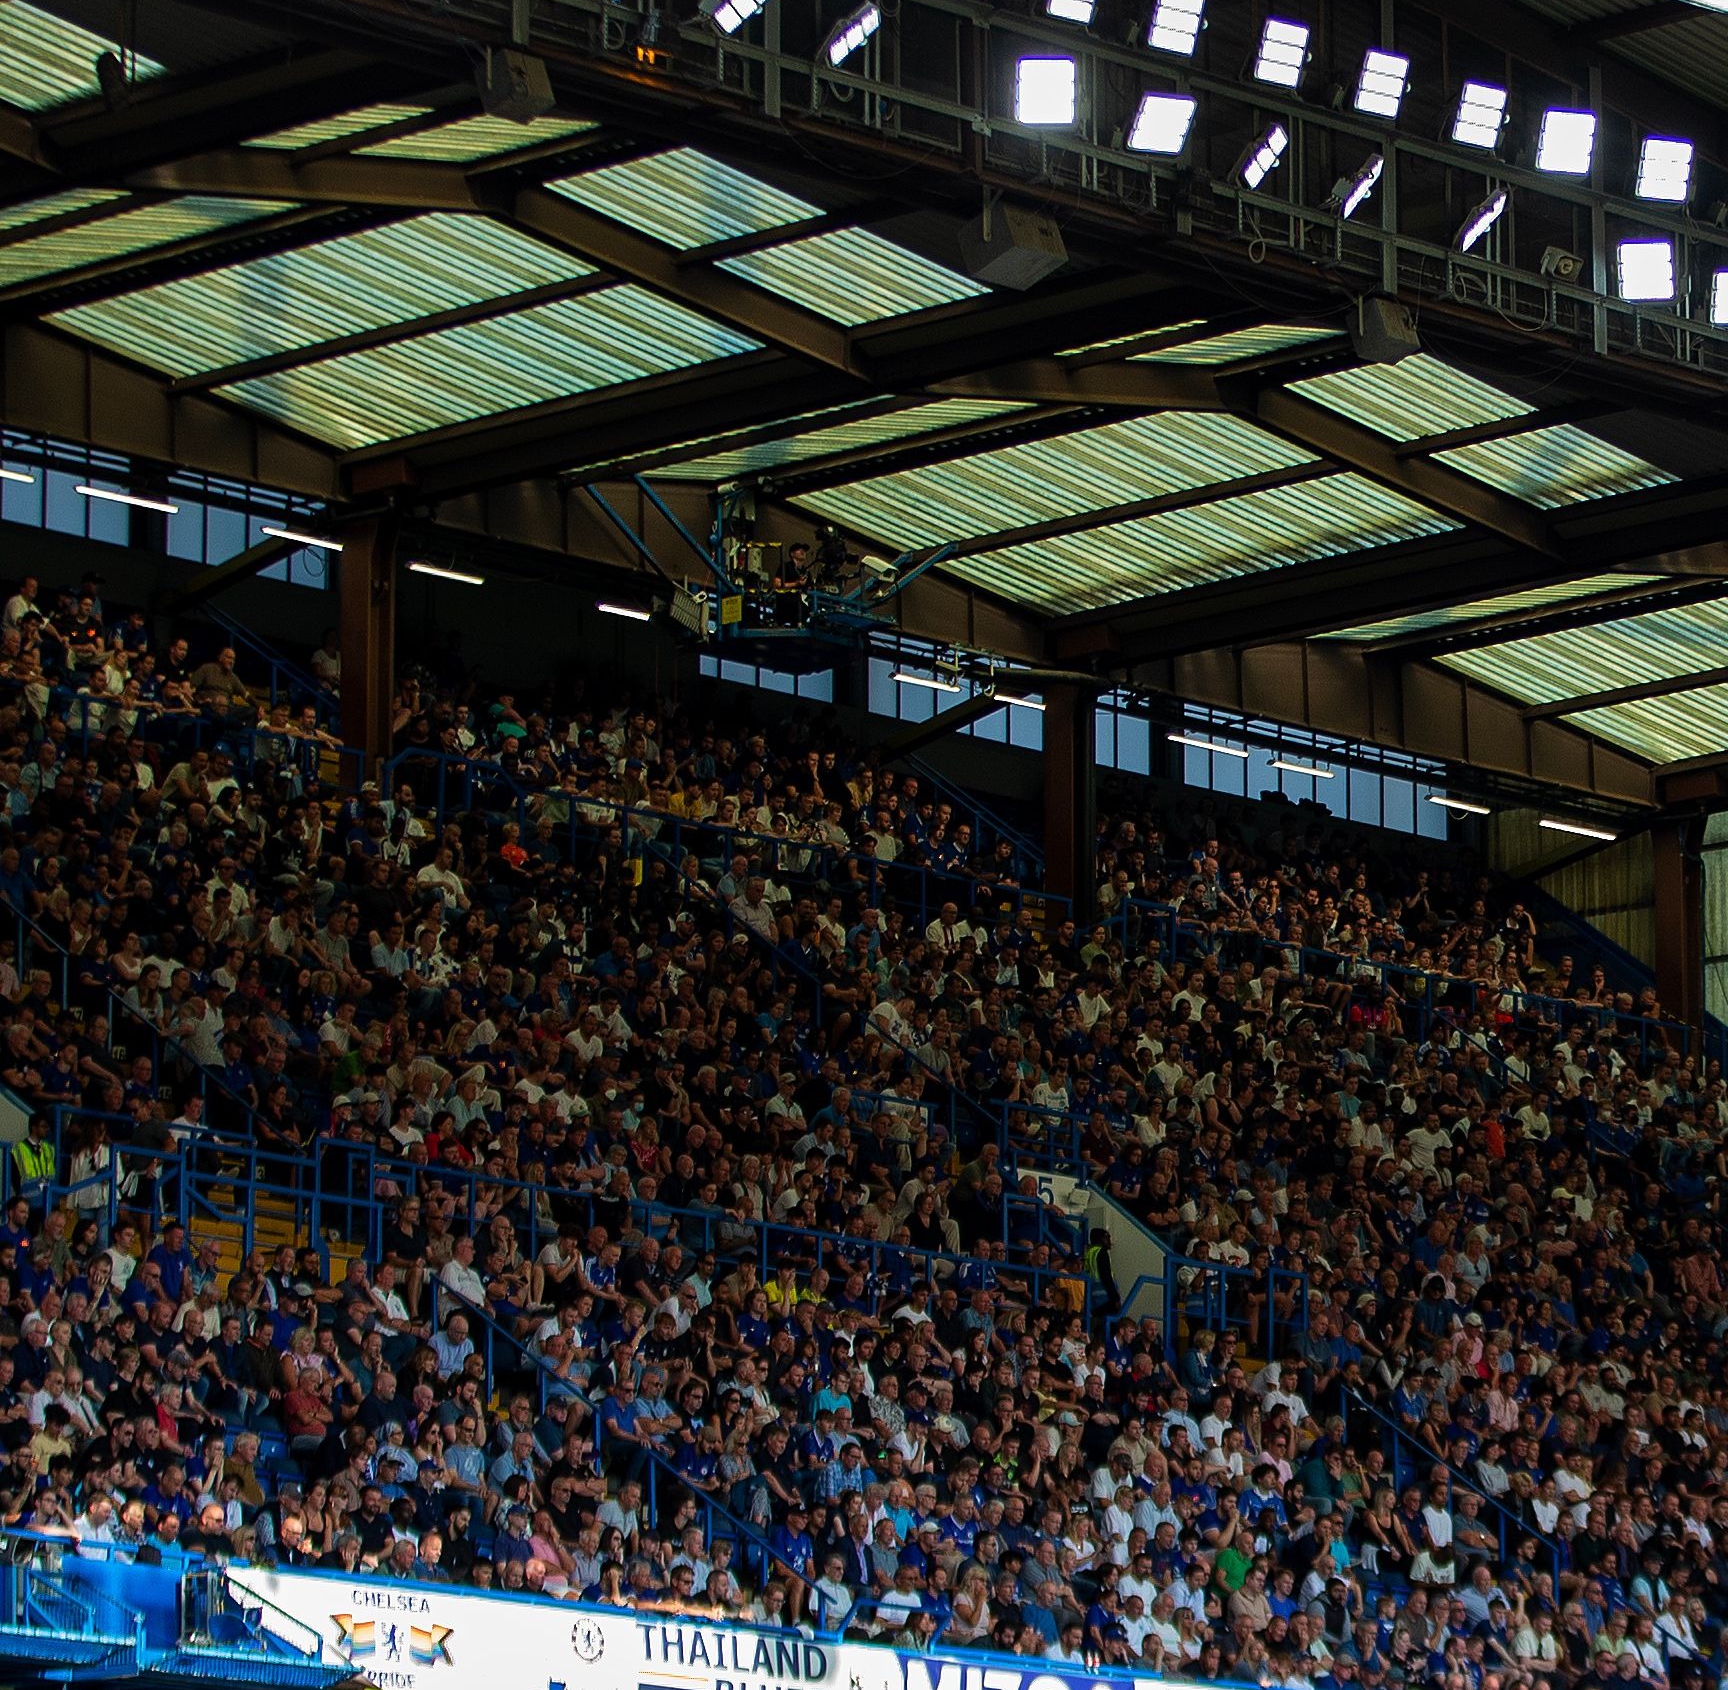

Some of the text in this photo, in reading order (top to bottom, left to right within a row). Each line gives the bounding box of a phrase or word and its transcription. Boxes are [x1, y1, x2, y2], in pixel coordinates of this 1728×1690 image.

[352, 1590, 430, 1613] CHELSEA
[636, 1623, 828, 1683] THAILAND
[366, 1669, 416, 1689] PRIDE
